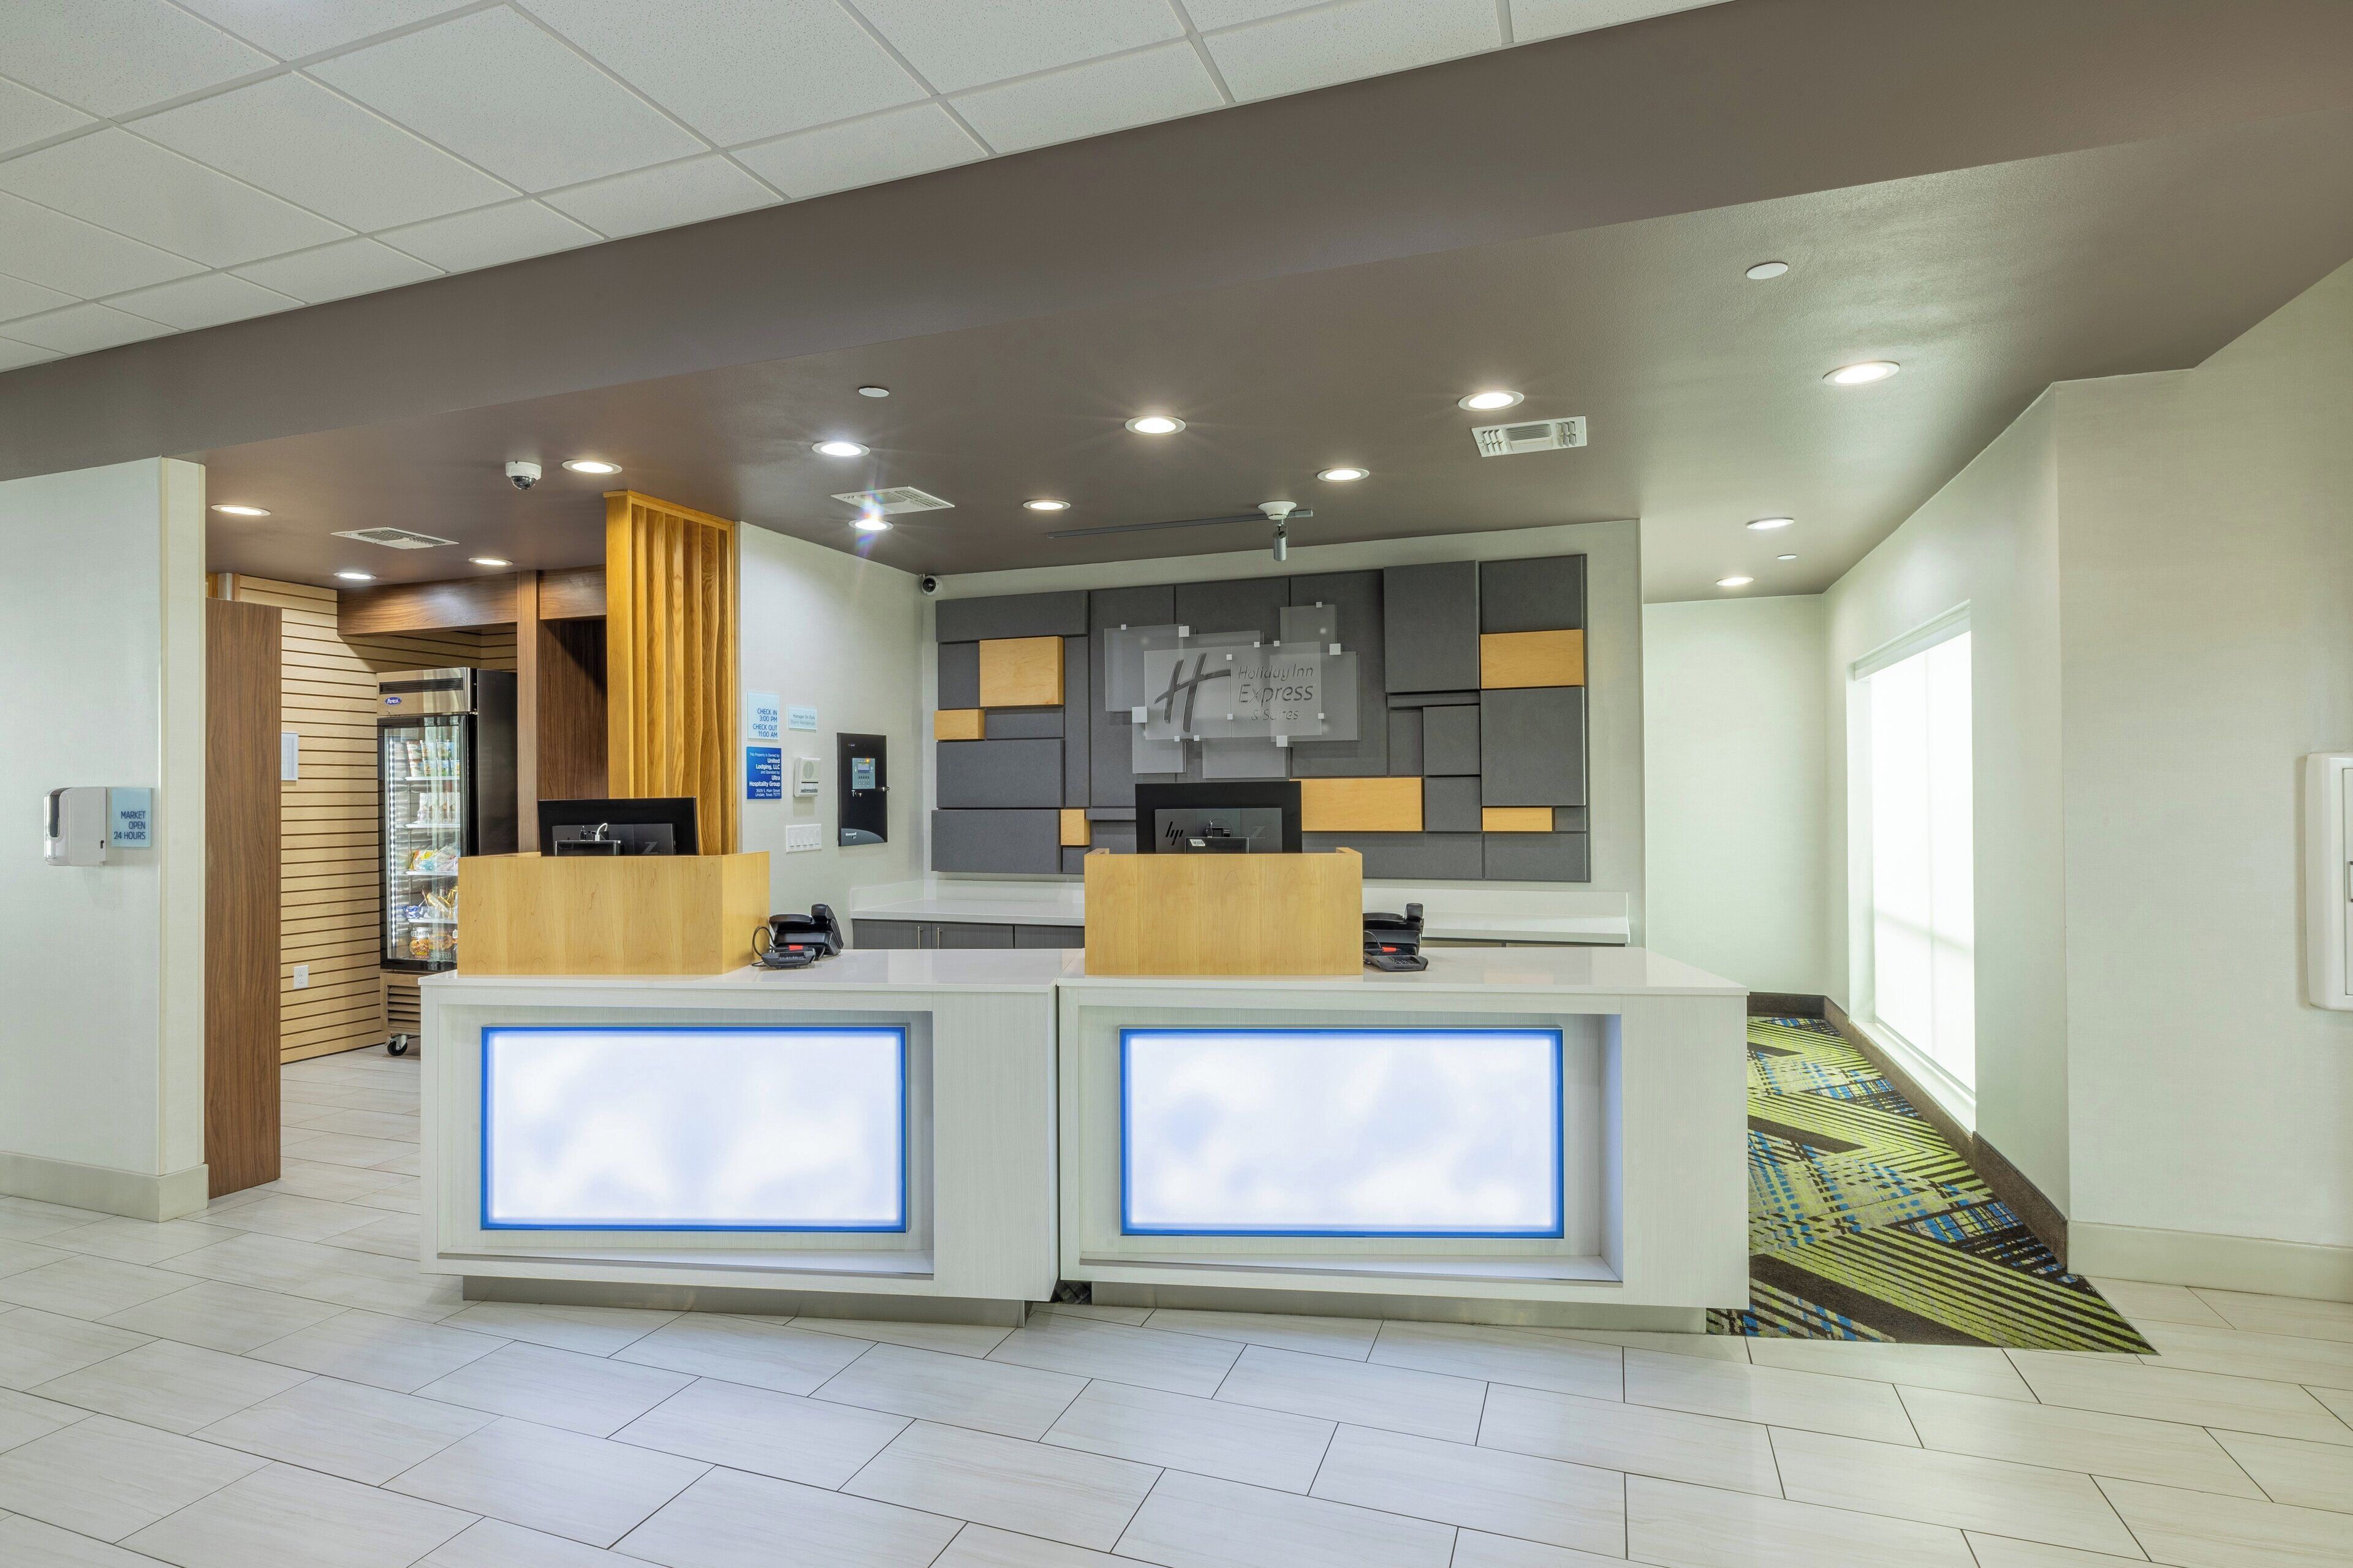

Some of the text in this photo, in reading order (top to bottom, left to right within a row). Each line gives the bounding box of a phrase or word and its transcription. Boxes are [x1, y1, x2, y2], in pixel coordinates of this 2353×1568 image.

[1238, 684, 1314, 707] Express
[1251, 709, 1299, 721] & Suites
[121, 811, 146, 819] MARKET
[128, 821, 146, 830] OPEN
[124, 831, 146, 840] HOURS
[1165, 821, 1184, 846] hp
